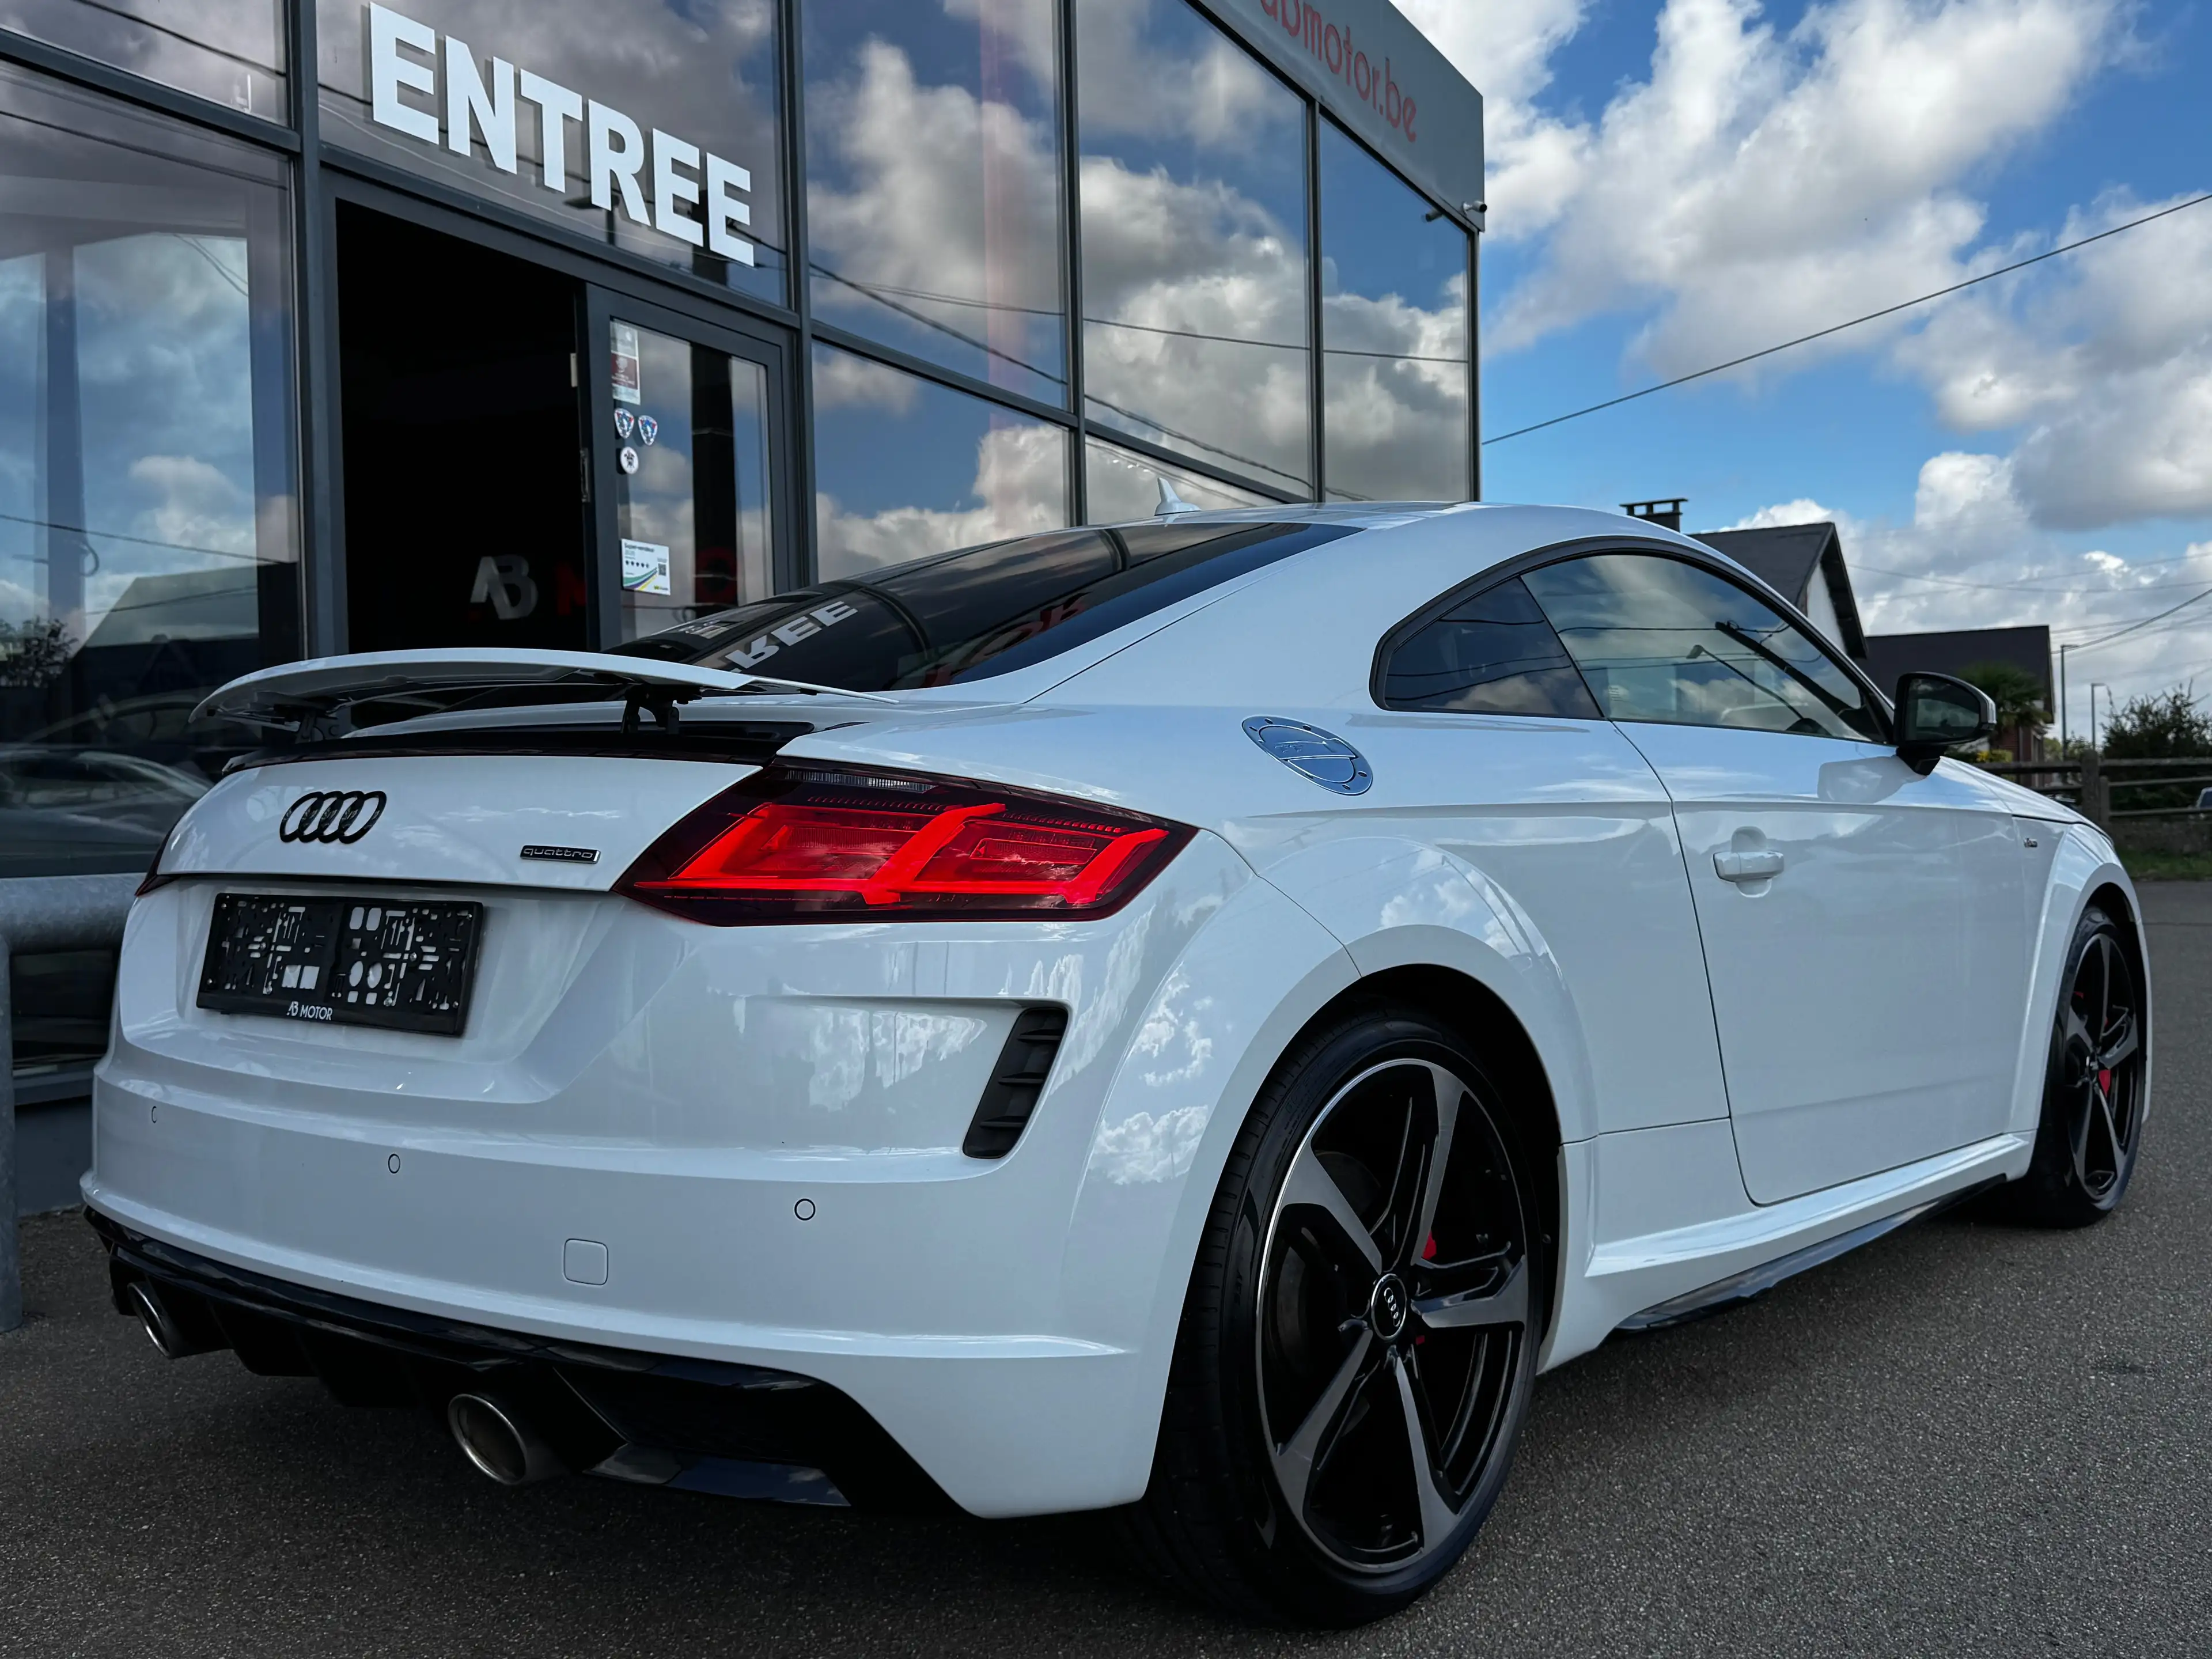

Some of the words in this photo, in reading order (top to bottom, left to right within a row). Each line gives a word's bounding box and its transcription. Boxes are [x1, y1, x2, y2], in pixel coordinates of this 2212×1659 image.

[370, 2, 754, 267] ENTREE
[523, 848, 593, 858] quattro
[300, 1005, 333, 1021] MOTOR
